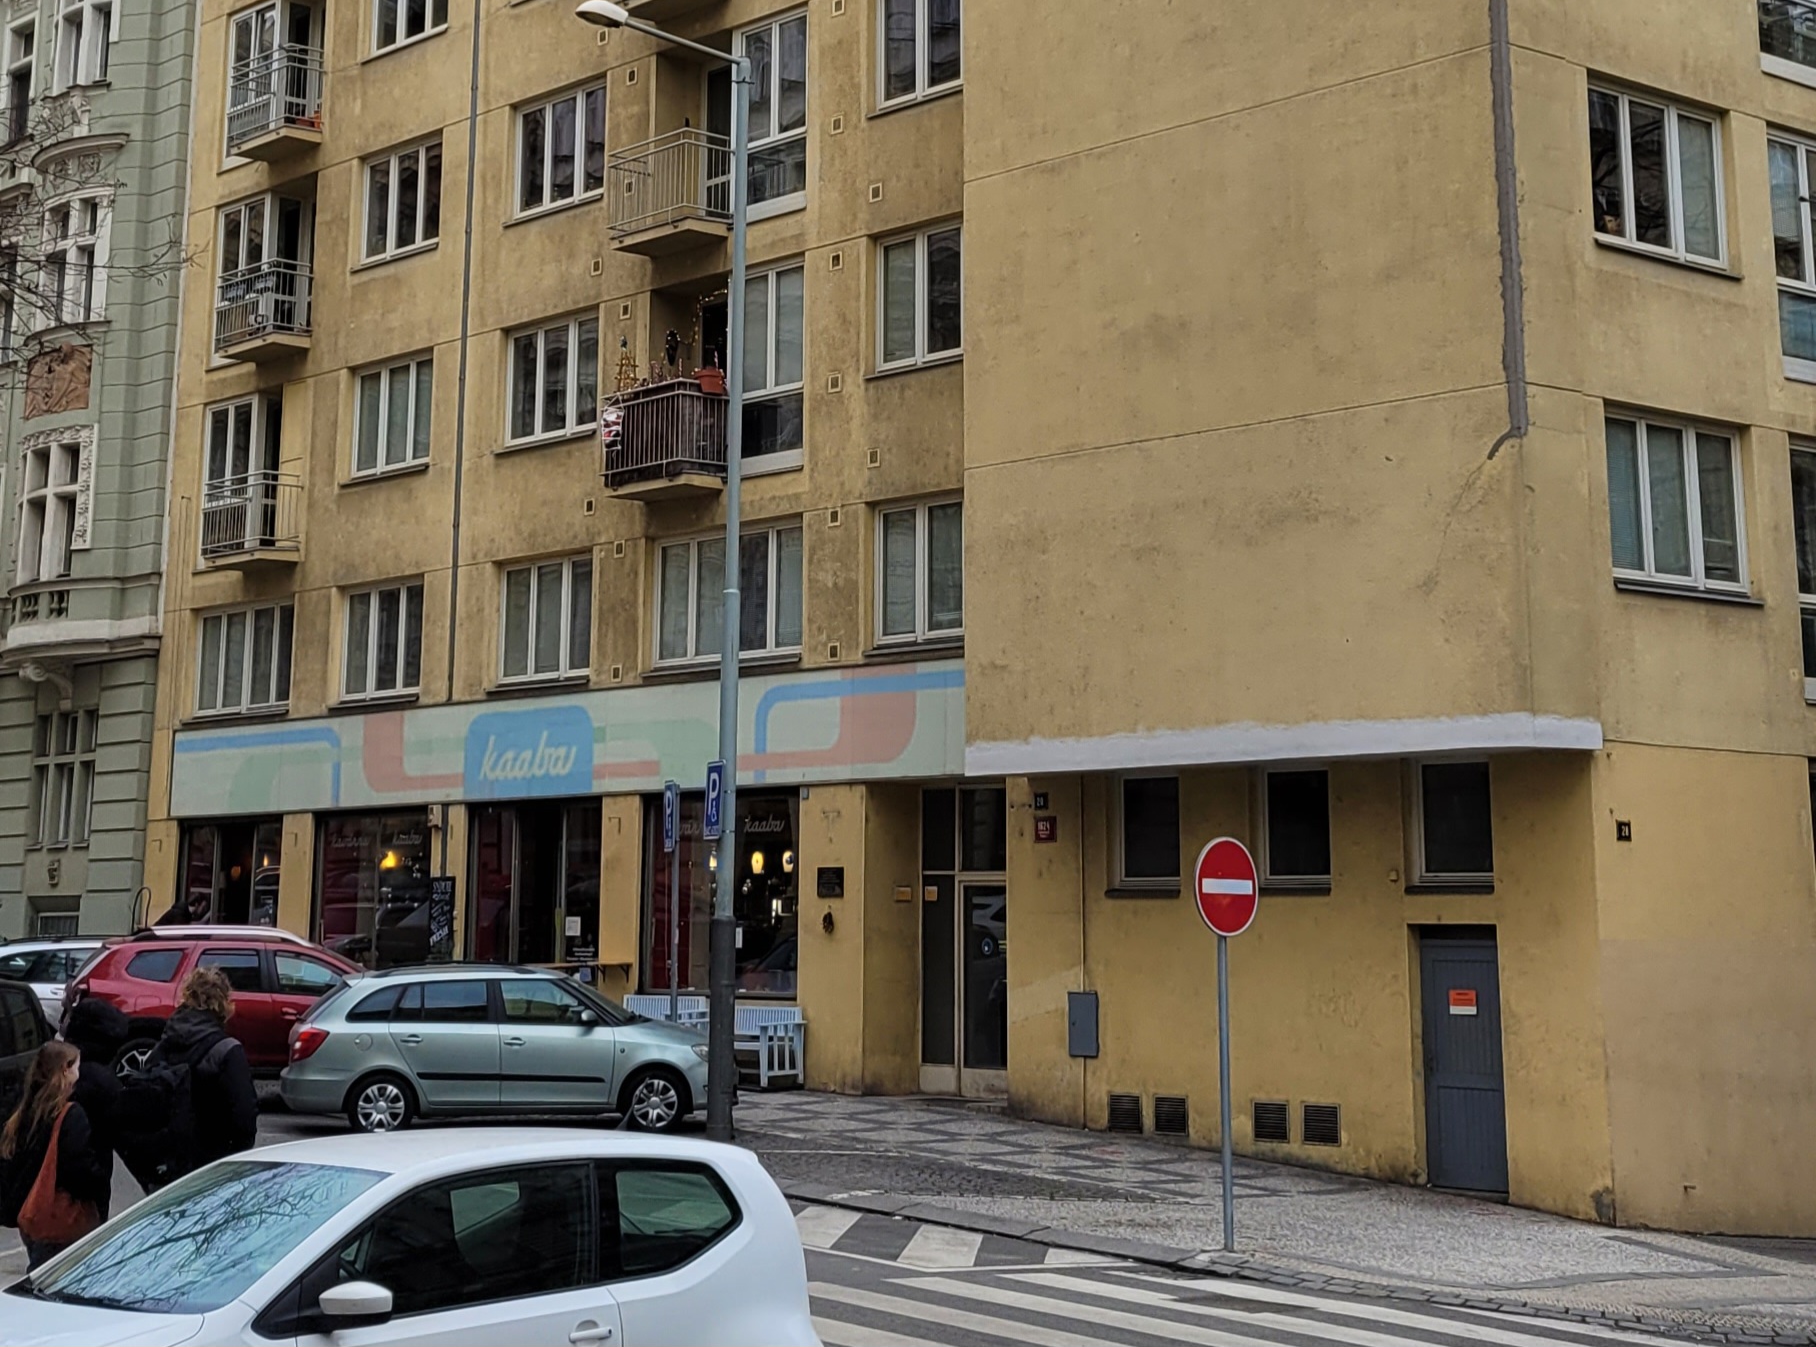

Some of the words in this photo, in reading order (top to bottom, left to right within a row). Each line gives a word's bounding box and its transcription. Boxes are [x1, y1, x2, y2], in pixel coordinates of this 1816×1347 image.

[479, 730, 576, 780] kaaba
[708, 772, 719, 816] P
[744, 814, 784, 834] kaaba
